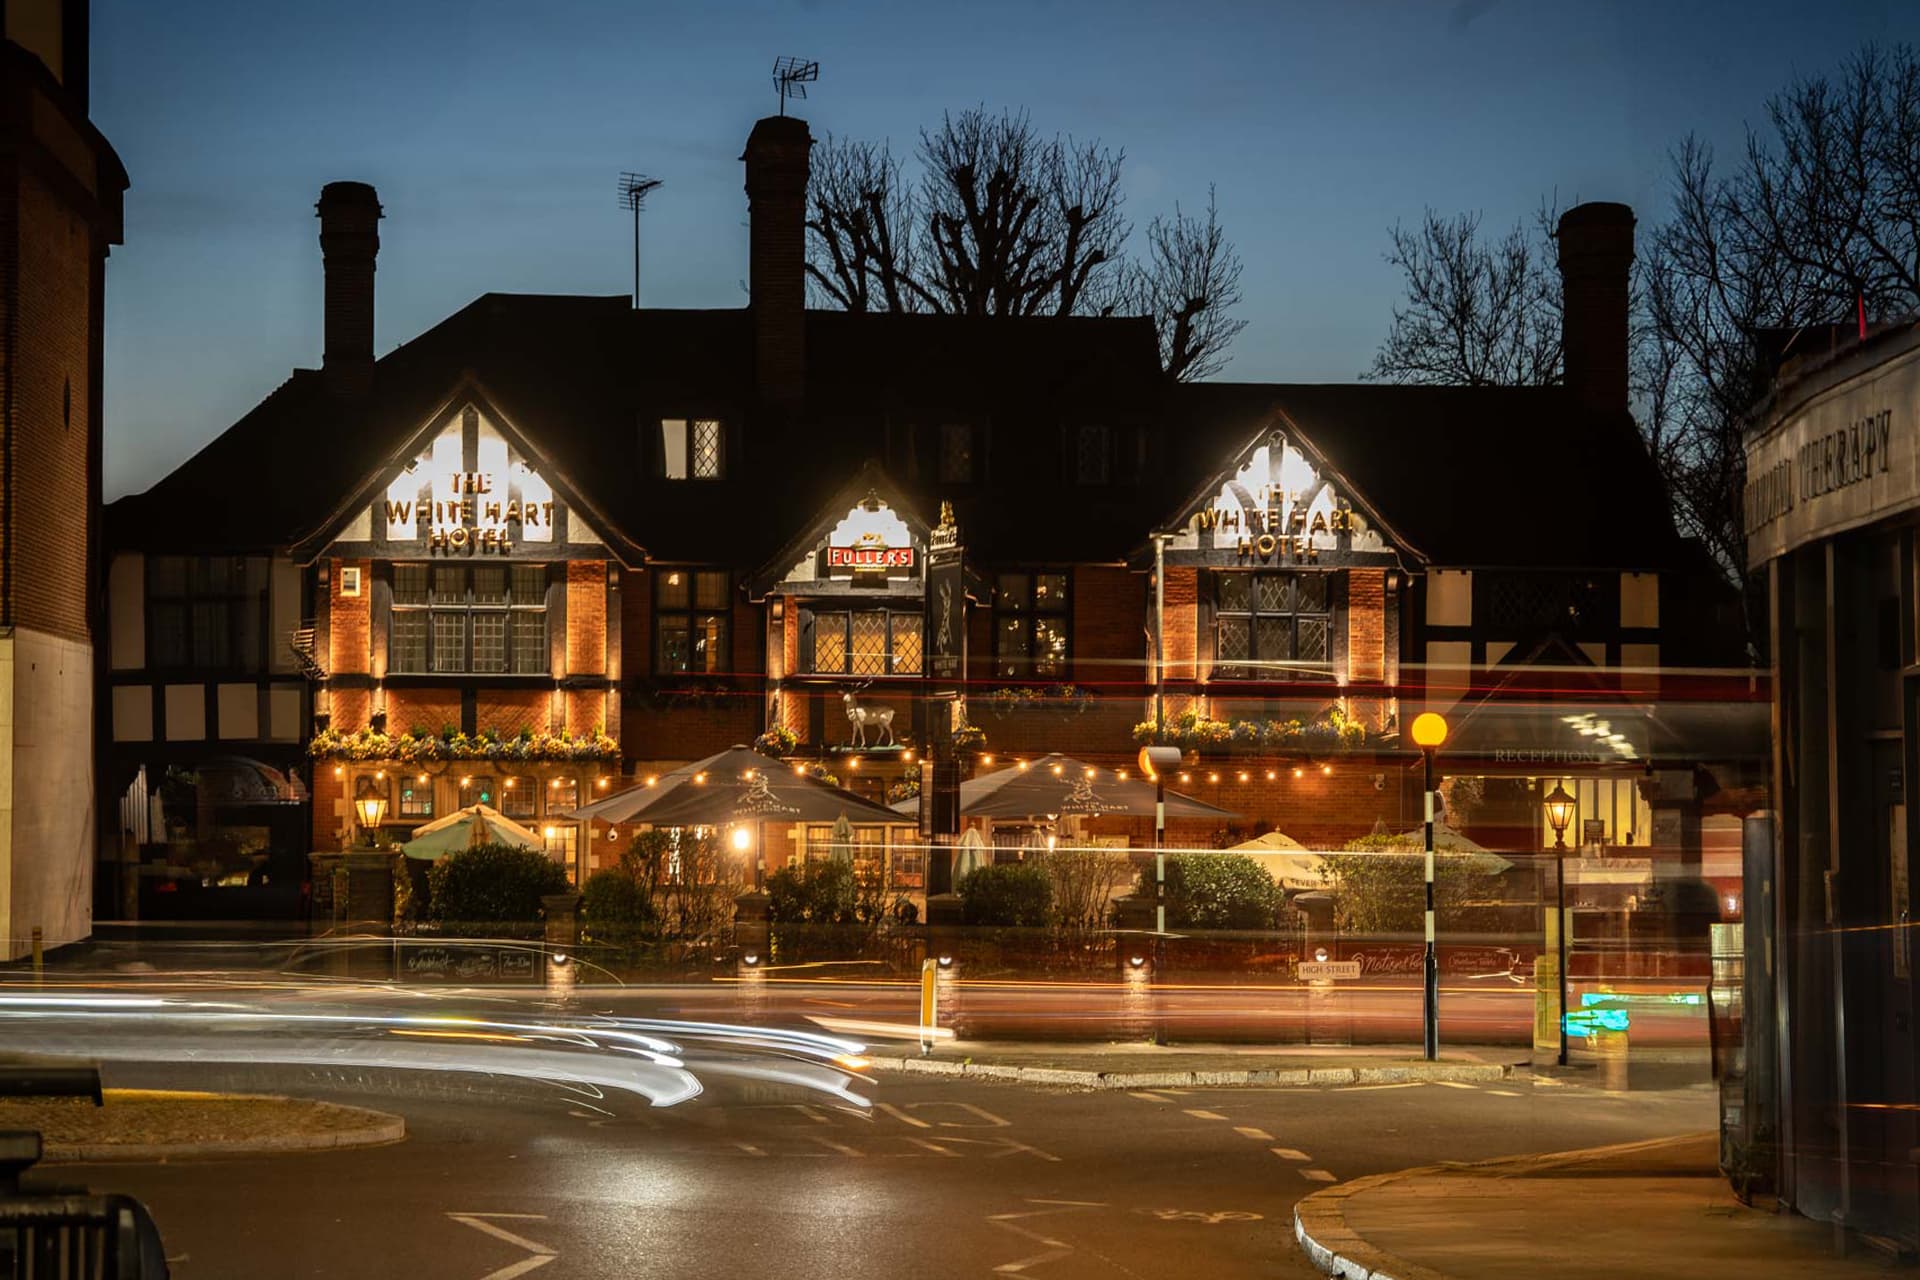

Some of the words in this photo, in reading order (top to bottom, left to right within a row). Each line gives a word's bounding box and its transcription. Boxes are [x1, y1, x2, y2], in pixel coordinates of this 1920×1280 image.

[1798, 409, 1892, 504] THERAPY
[451, 473, 493, 495] THE
[385, 498, 471, 525] WHITE
[484, 500, 555, 527] HART
[1200, 507, 1280, 533] WHITE
[1291, 508, 1354, 535] HART
[428, 526, 514, 554] HOTEL
[1237, 534, 1319, 558] HOTEL
[831, 549, 908, 565] FULLER'S
[1495, 749, 1595, 763] RECEPTION
[1302, 965, 1323, 976] HIGH
[1325, 964, 1357, 975] STREET
